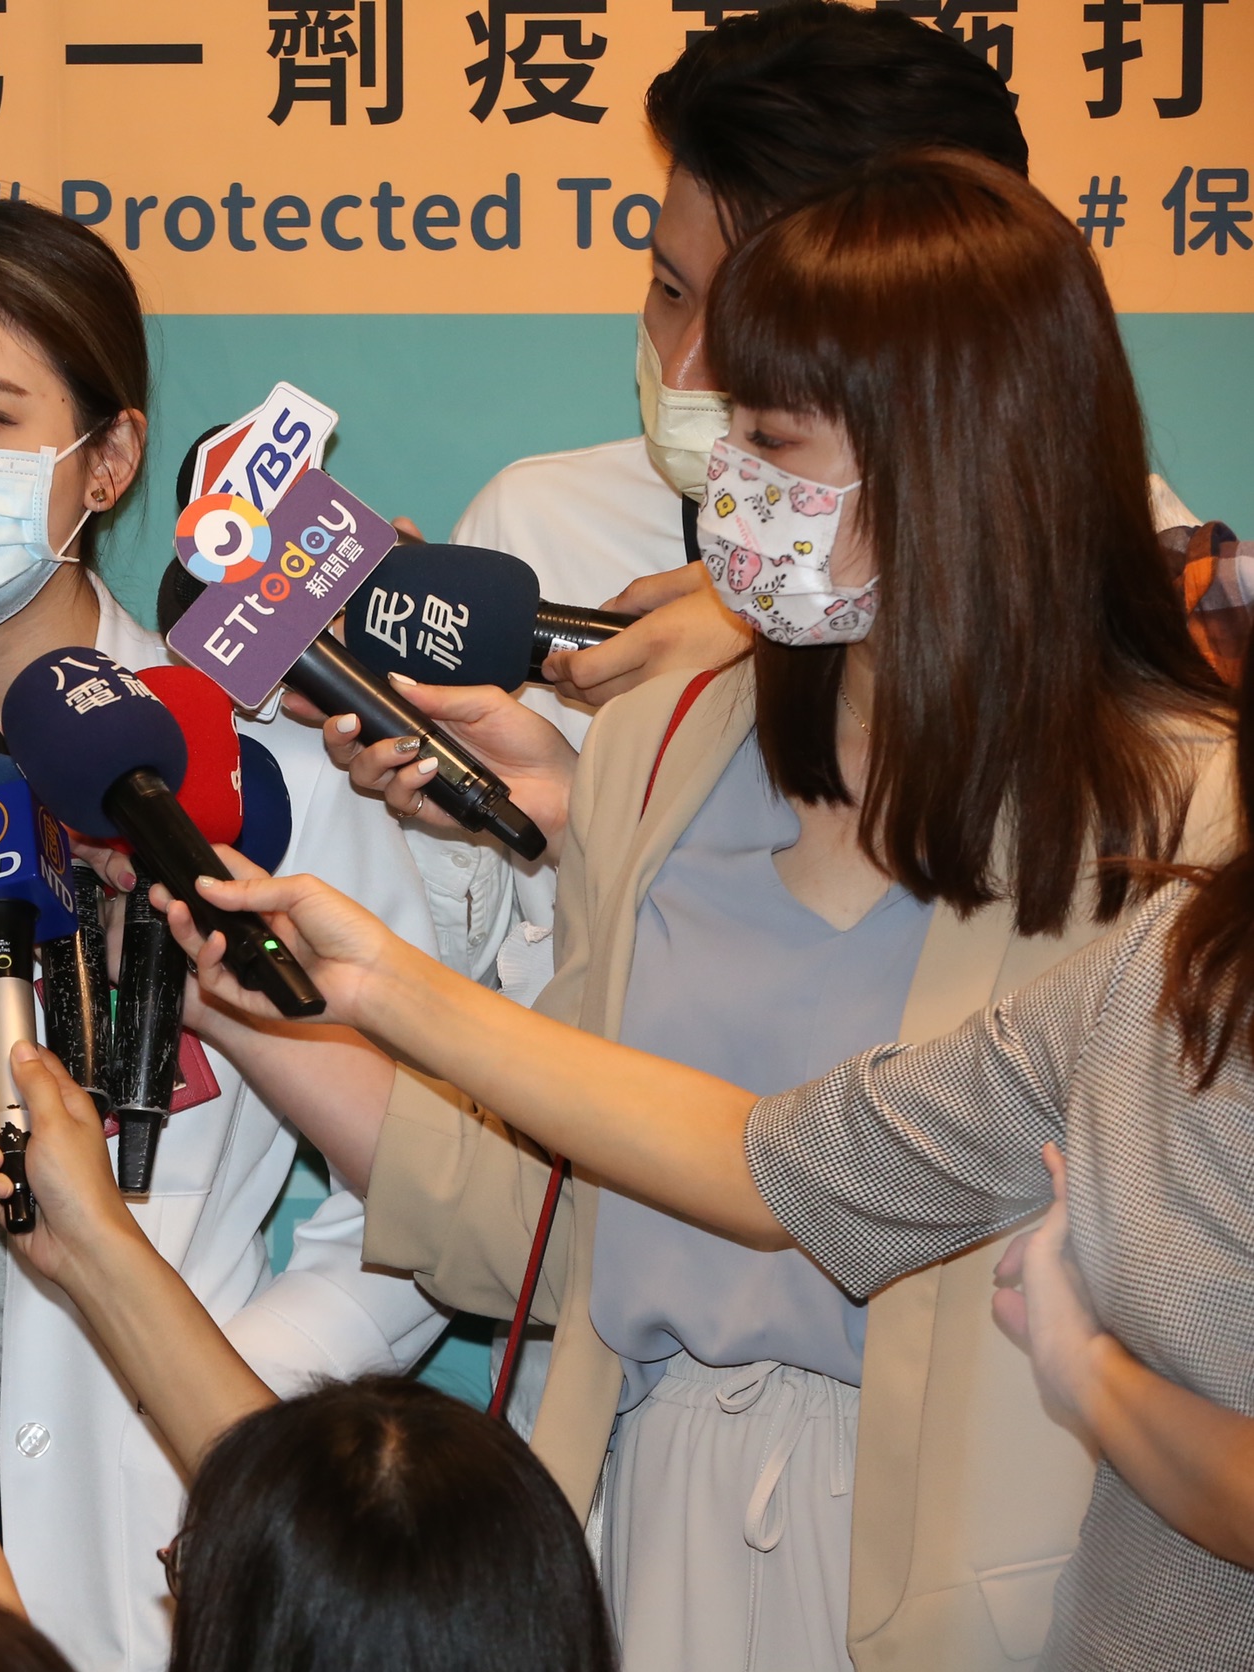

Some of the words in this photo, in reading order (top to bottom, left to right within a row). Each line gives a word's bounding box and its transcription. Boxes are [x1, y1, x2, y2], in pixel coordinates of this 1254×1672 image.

[62, 173, 520, 251] Protected
[1076, 175, 1128, 248] #
[1162, 165, 1253, 257] 保
[219, 407, 311, 512] VBS
[304, 536, 364, 599] 新聞雲
[365, 586, 470, 670] 民視
[41, 854, 74, 913] NTD
